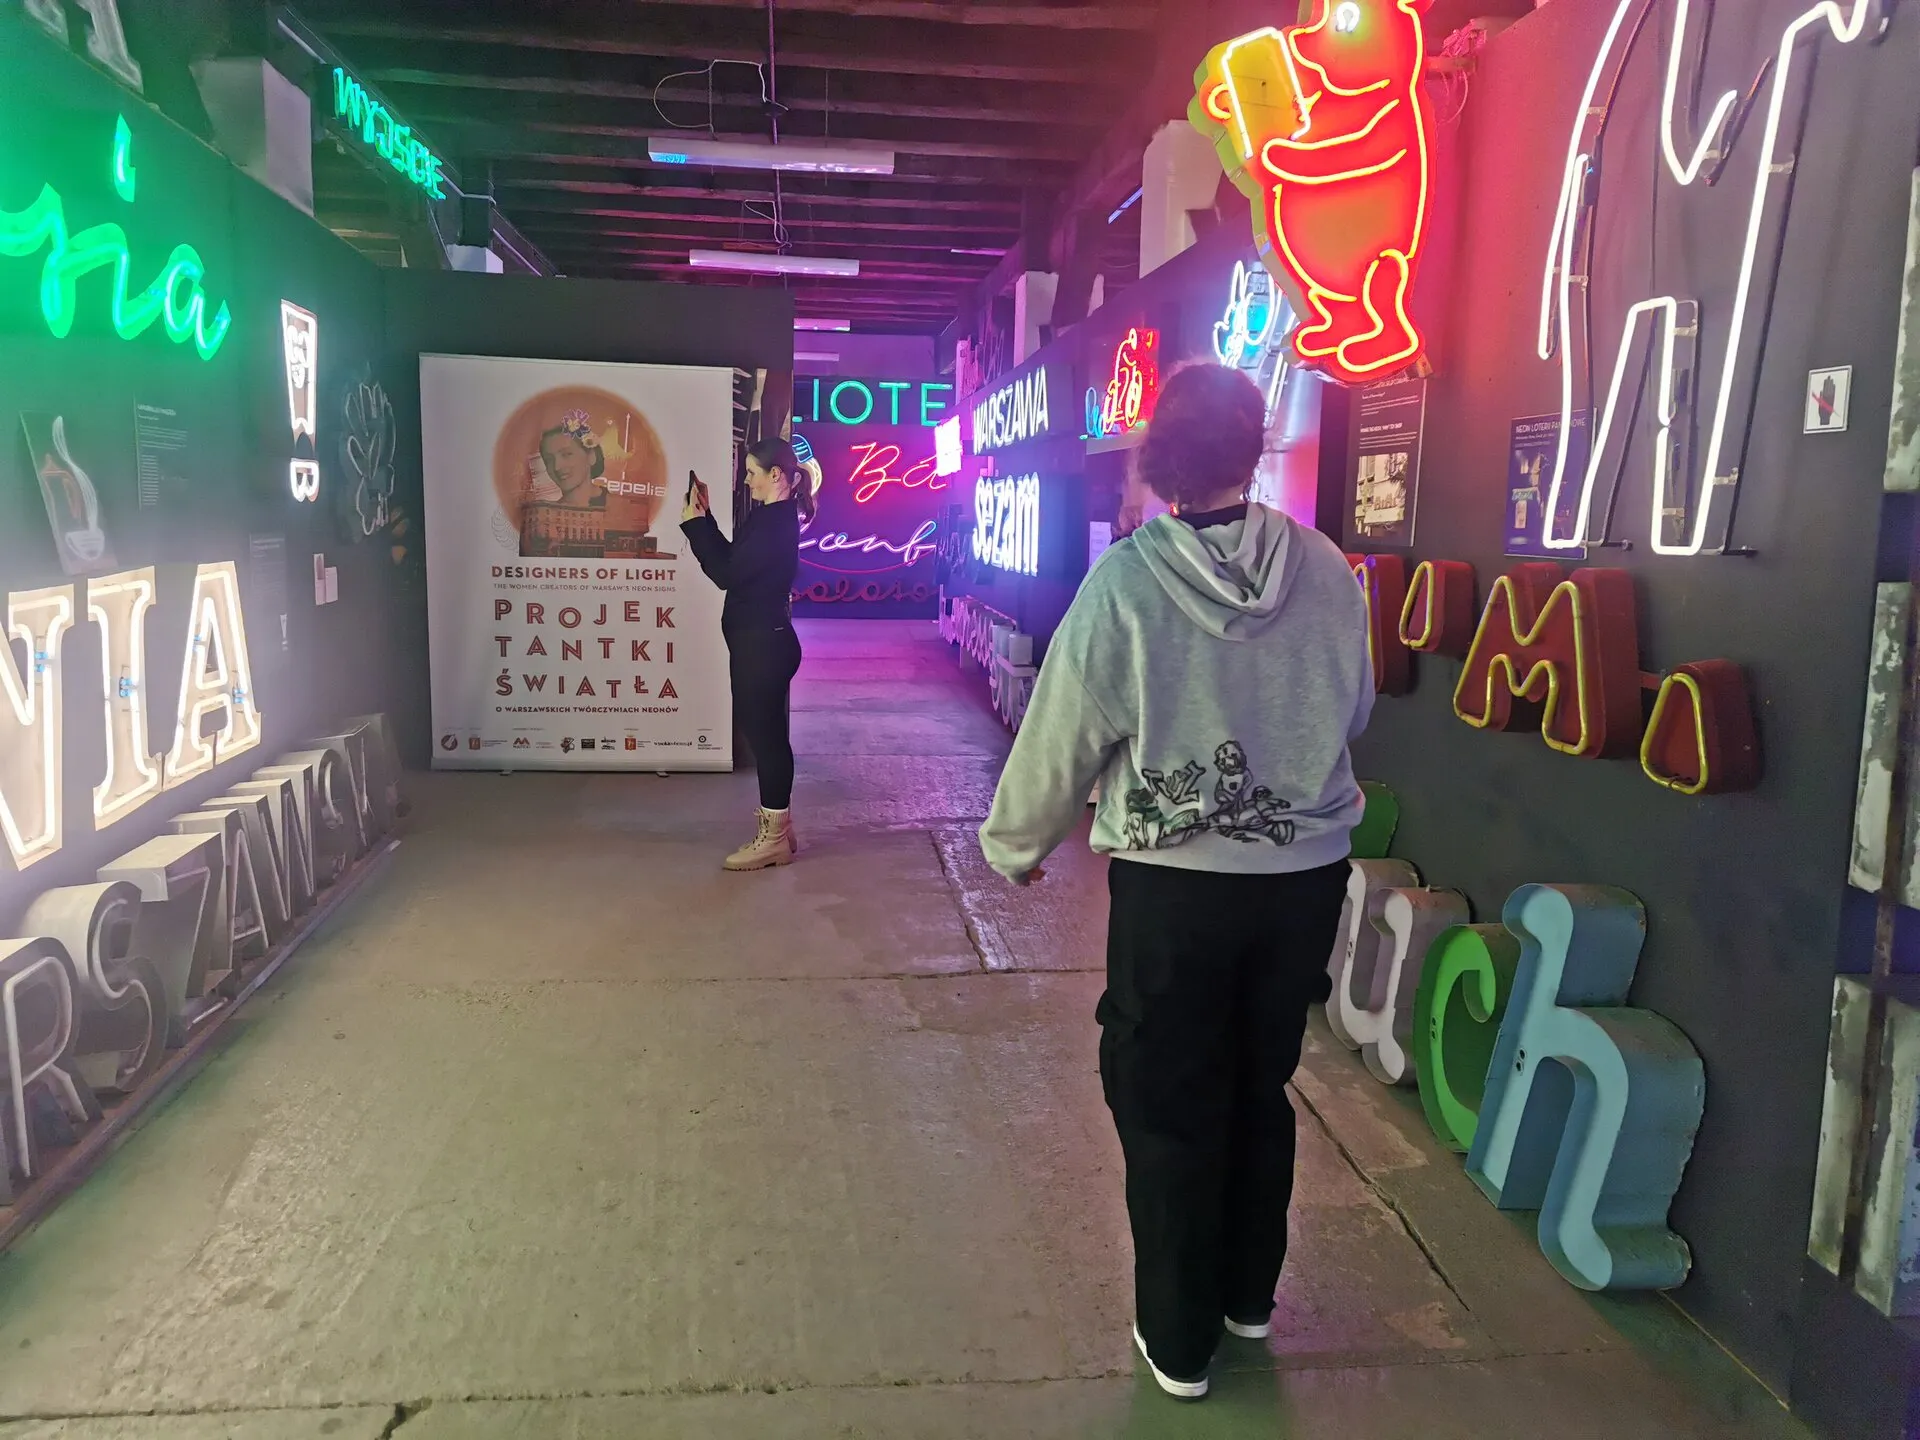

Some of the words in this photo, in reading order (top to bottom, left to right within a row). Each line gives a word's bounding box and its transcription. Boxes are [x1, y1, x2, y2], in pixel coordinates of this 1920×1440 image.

[792, 378, 953, 426] IOTE
[973, 363, 1049, 455] WARSZAWA
[491, 566, 589, 579] DESIGNERS
[596, 568, 618, 580] OF
[625, 569, 677, 581] LIGHT
[494, 598, 676, 629] PROJEK
[494, 634, 675, 664] TANTKI
[495, 668, 679, 699] ŚWIATŁA
[495, 705, 503, 713] O
[505, 705, 571, 714] WARSZAWSKICH
[573, 705, 640, 714] TWÓRCZYNIACH
[642, 705, 679, 714] NEONÓW
